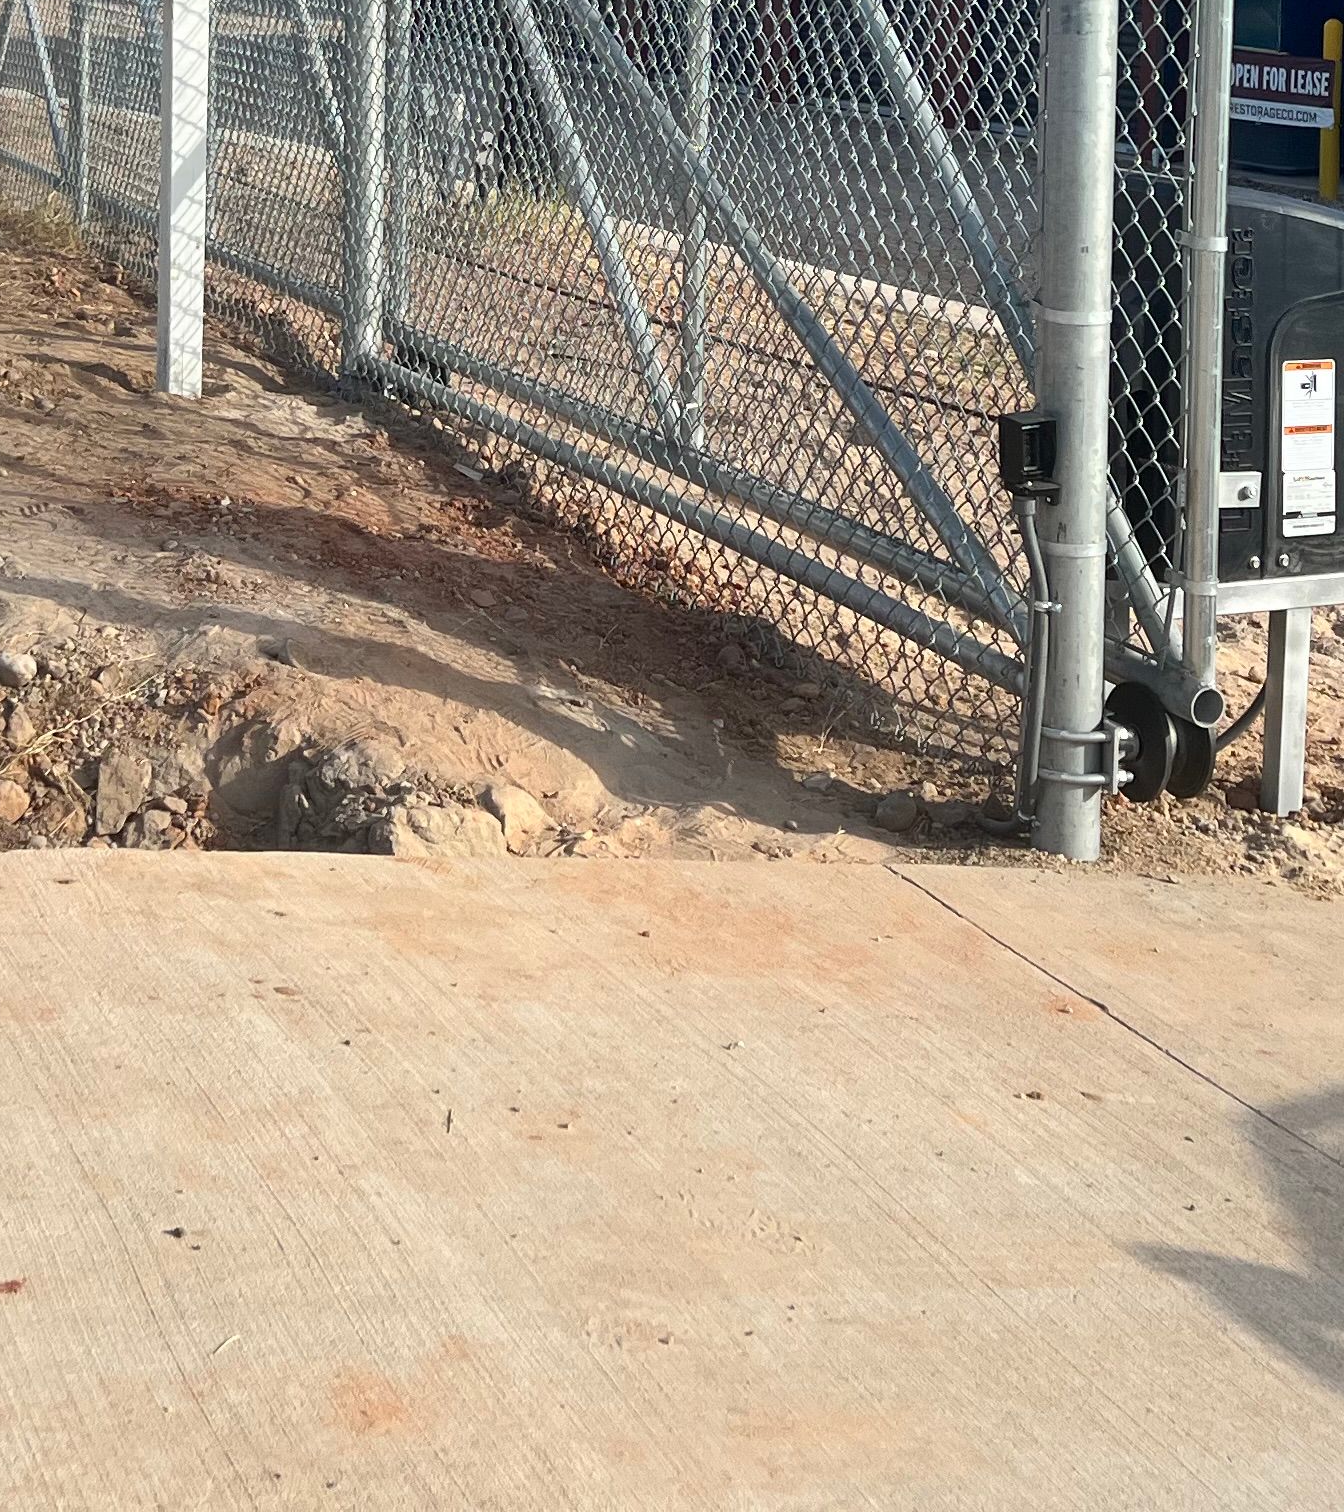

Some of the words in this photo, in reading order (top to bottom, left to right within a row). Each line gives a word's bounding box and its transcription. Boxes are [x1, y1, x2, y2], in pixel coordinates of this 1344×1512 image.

[1263, 66, 1287, 92] FOR
[1290, 69, 1330, 96] LEASE
[1221, 226, 1253, 532] LftMaster
